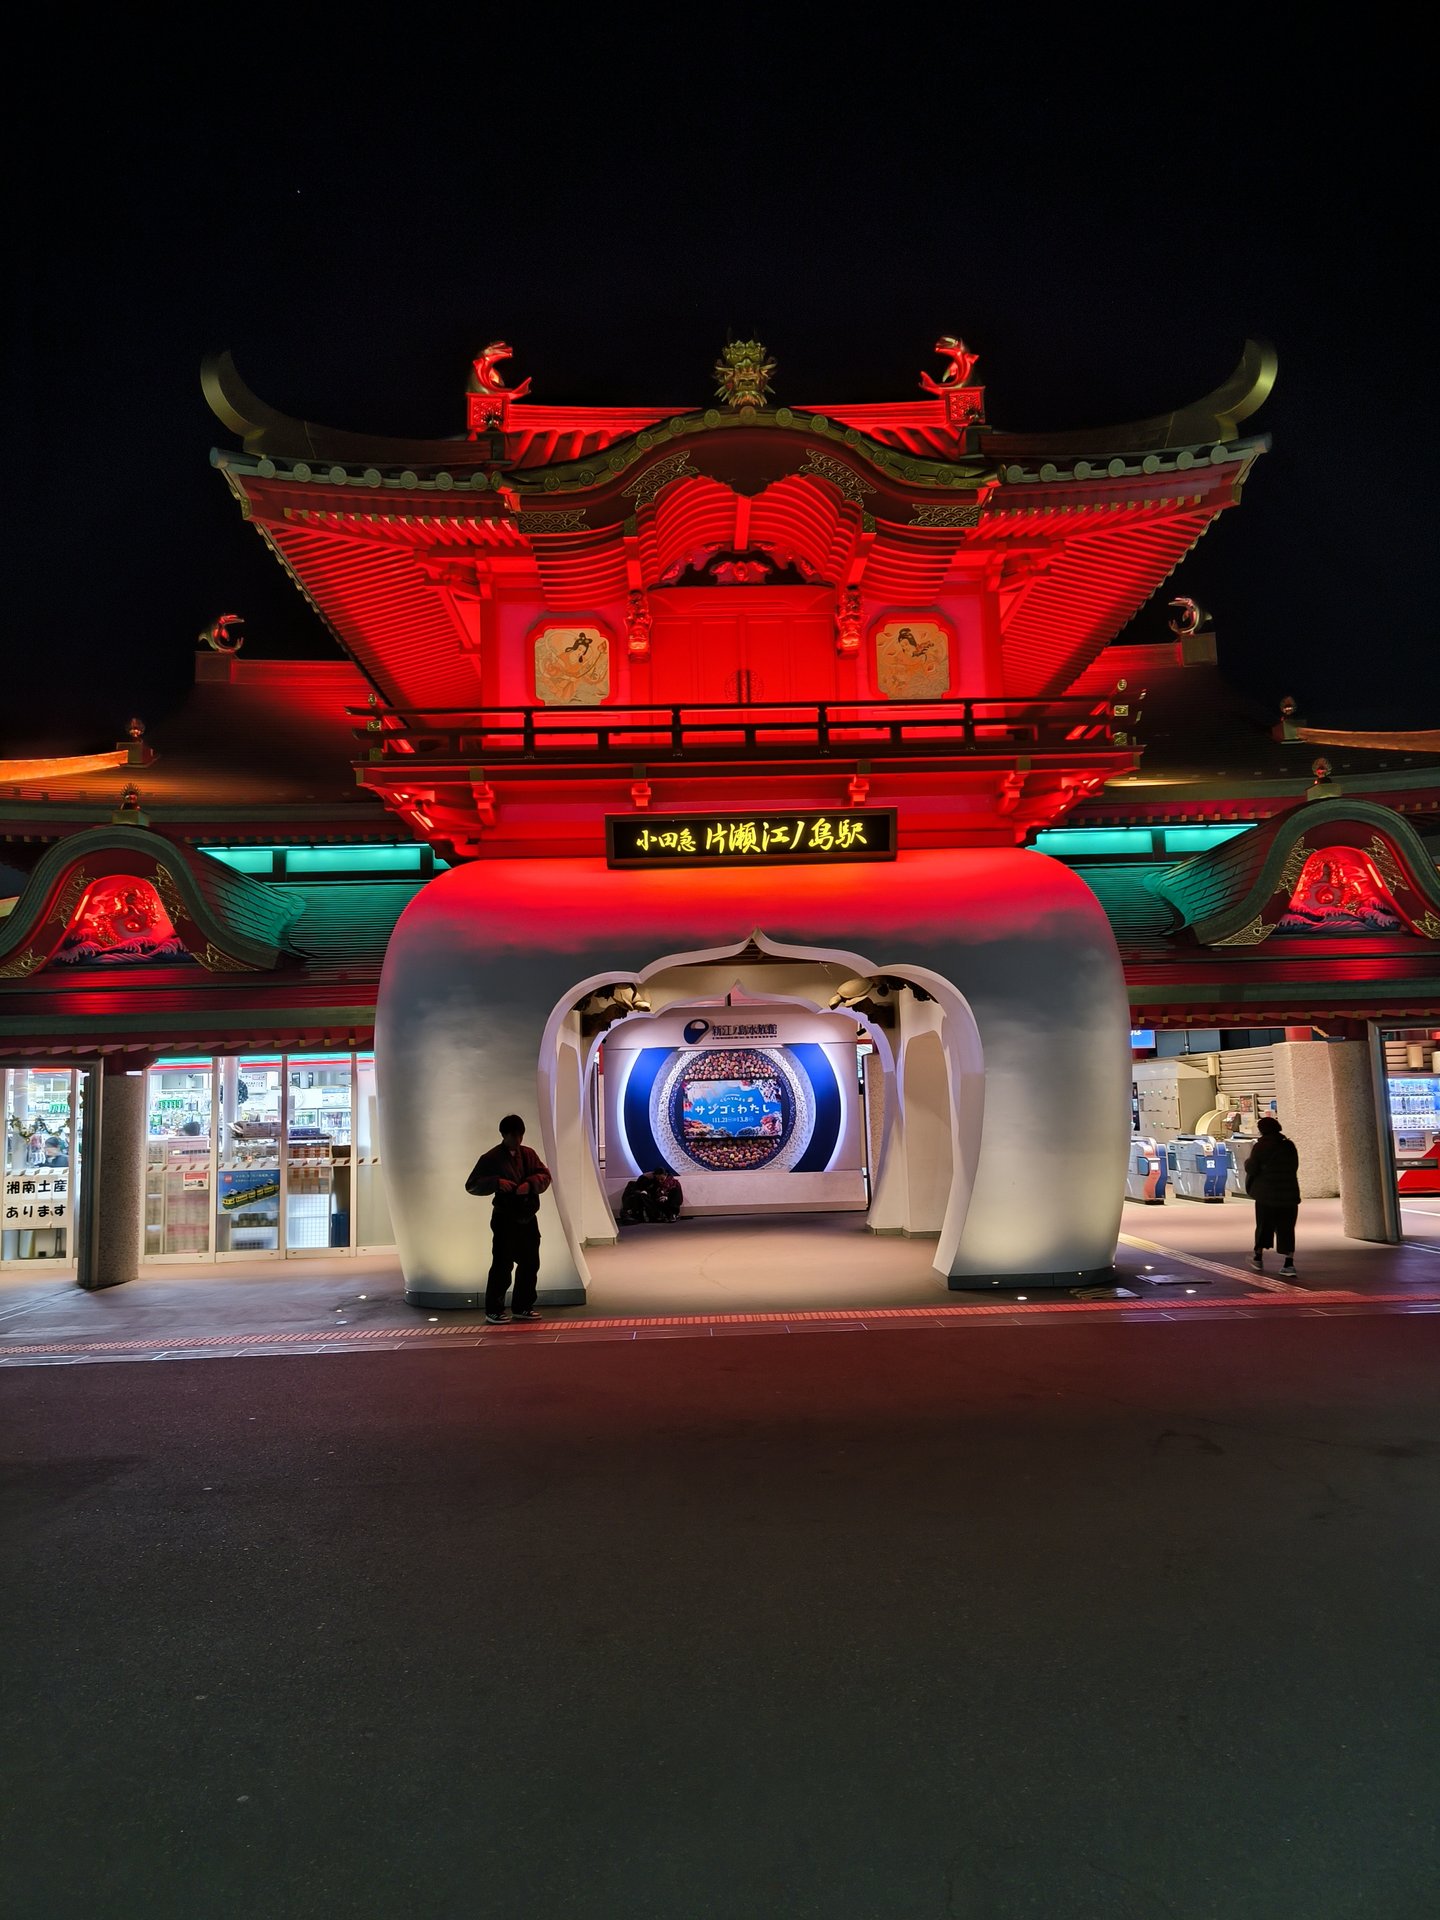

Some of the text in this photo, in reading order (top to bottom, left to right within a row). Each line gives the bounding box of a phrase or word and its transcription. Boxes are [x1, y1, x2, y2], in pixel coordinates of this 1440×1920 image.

[636, 817, 868, 854] 小田急 片瀬江ノ島駅
[6, 1179, 68, 1195] 湘南土産
[6, 1204, 67, 1219] あります
